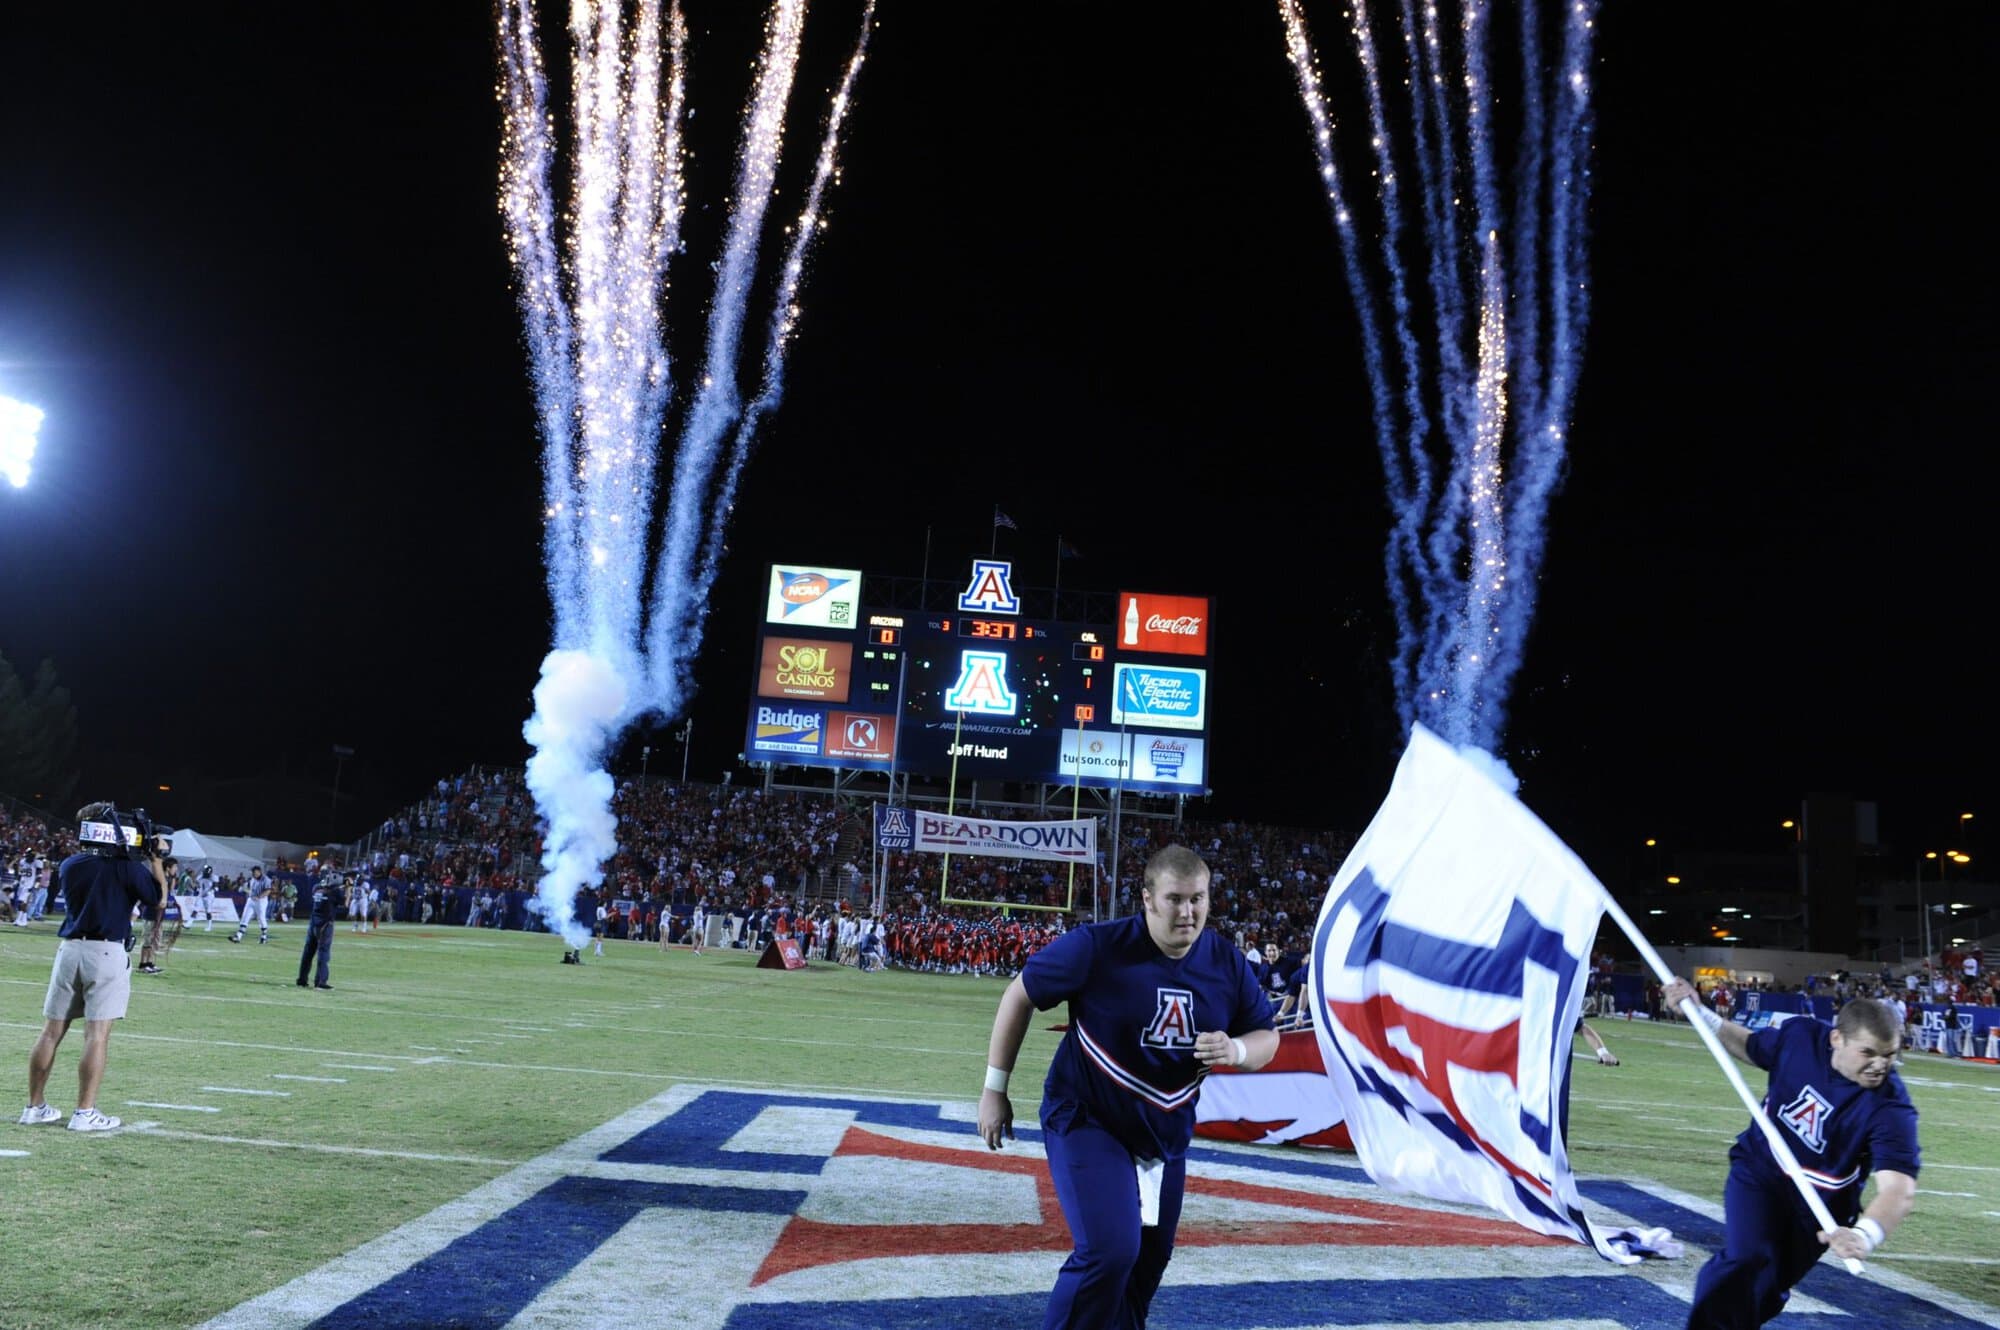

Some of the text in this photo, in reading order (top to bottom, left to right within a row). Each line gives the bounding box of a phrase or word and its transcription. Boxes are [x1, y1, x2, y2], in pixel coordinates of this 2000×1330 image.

[788, 585, 821, 597] NCAA
[958, 559, 1021, 615] A
[942, 620, 950, 631] 3
[971, 621, 1015, 639] 3:37
[1024, 627, 1034, 638] 3
[881, 630, 894, 643] 0
[777, 645, 836, 677] SOL
[1090, 646, 1103, 660] 0
[776, 672, 836, 689] CASINOS
[945, 650, 1017, 716] A
[1139, 673, 1182, 689] Tucson
[1143, 686, 1192, 700] Electric
[1147, 698, 1191, 711] Power
[758, 706, 822, 732] Budget
[974, 745, 1008, 759] Hund
[880, 807, 911, 836] A
[880, 837, 910, 848] CLUB
[997, 826, 1088, 849] DOWN
[1140, 987, 1200, 1049] A
[1777, 1083, 1834, 1154] A
